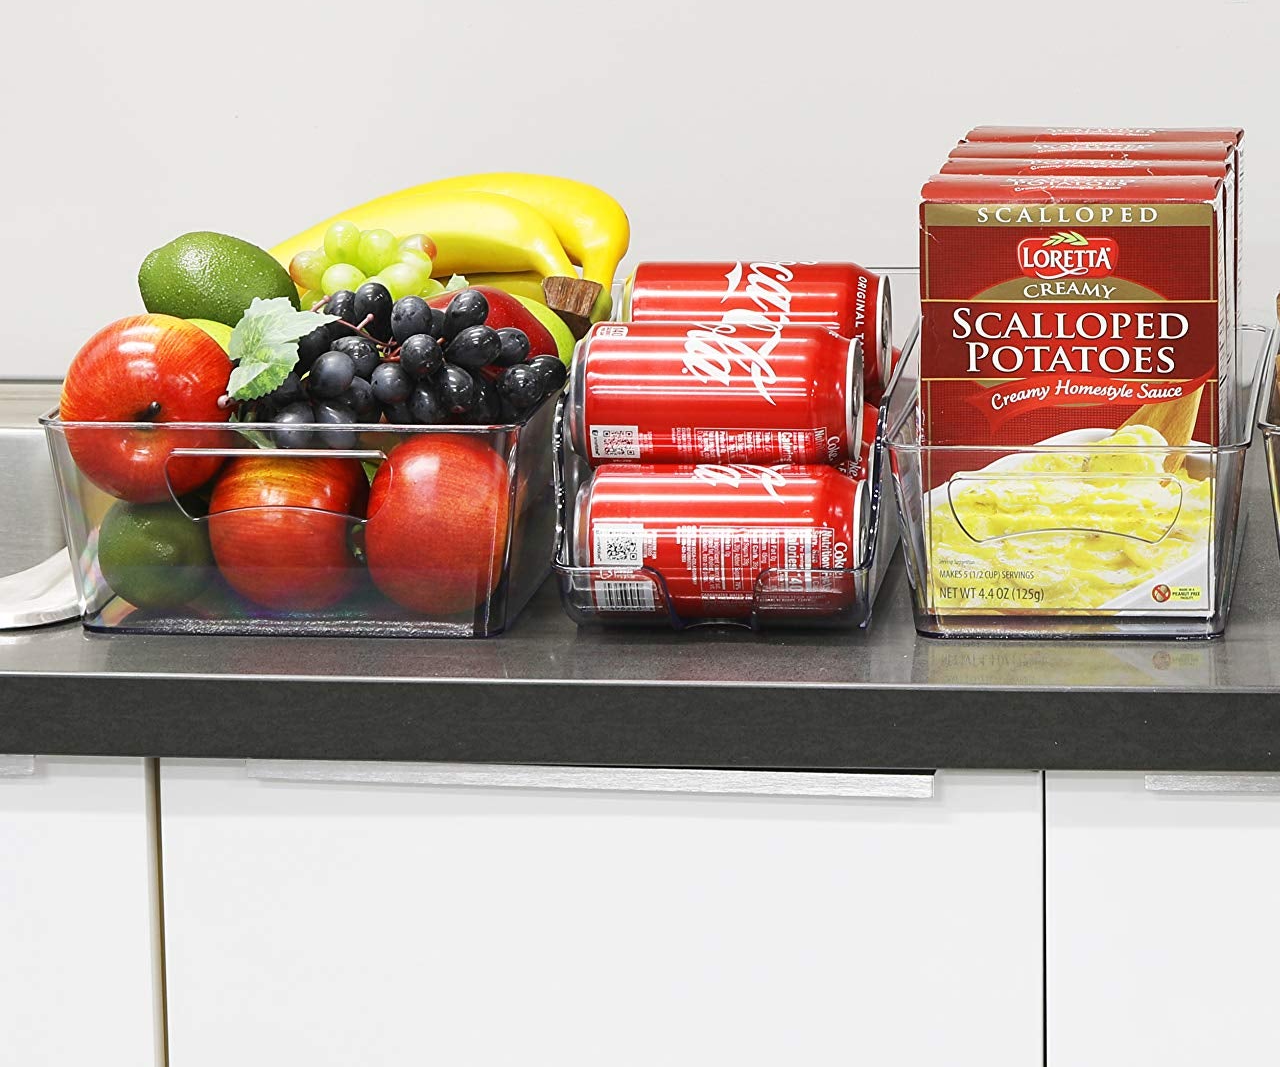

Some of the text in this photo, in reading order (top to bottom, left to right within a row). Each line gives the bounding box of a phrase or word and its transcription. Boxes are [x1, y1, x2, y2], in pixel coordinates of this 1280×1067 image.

[978, 207, 1158, 223] SCALLOPED
[1023, 247, 1110, 270] LORETTA
[855, 275, 867, 327] ORIGINAL
[1023, 282, 1116, 299] CREAMY
[953, 308, 1189, 339] SCALLOPED
[965, 342, 1175, 373] POTATOES
[991, 380, 1182, 410] Creamy Homestyle Sauce
[940, 570, 962, 578] MAKES
[970, 571, 983, 579] (1/2
[985, 570, 1000, 579] CUP)
[1002, 571, 1034, 579] SERVINGS
[940, 587, 1044, 602] NET WT 4.4 OZ (125g)
